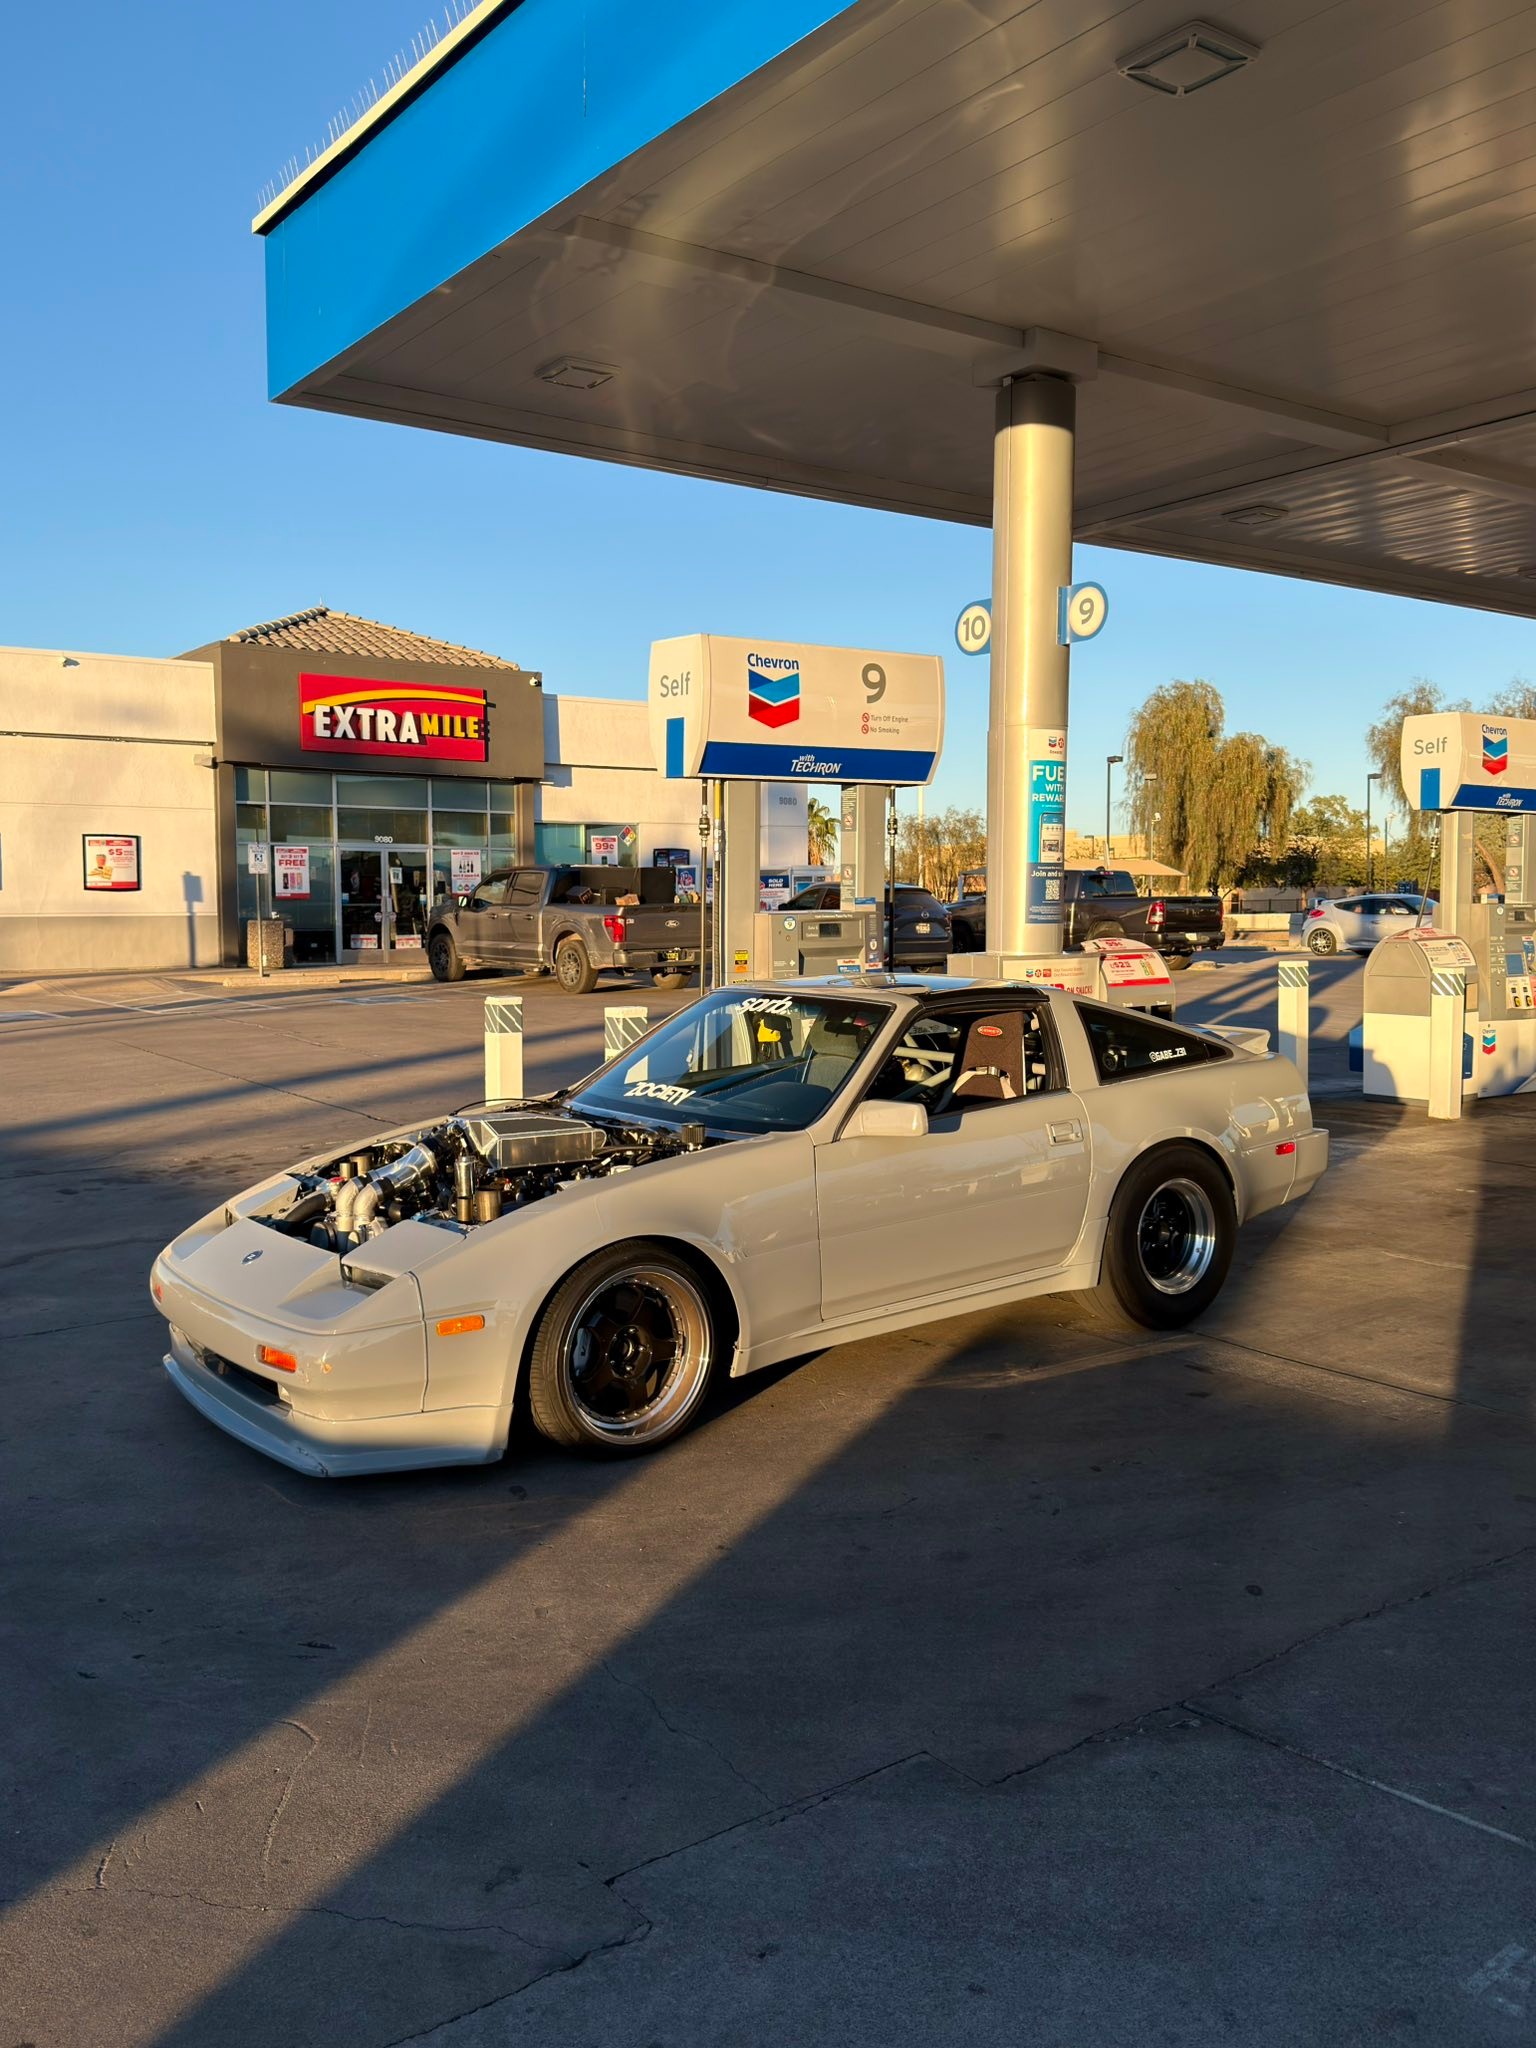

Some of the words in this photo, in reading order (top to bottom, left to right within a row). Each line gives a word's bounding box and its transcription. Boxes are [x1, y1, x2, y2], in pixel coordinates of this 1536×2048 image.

[1079, 598, 1094, 624] 9
[962, 615, 986, 642] 10
[748, 653, 799, 670] Chevron
[660, 671, 690, 698] Self
[862, 662, 886, 704] 9
[314, 704, 420, 744] EXTRA
[420, 712, 479, 738] MILE
[1482, 724, 1507, 736] Chevron
[1414, 737, 1448, 755] Self
[799, 754, 815, 762] with
[790, 760, 841, 775] TECHRON
[1032, 765, 1064, 781] FUE
[779, 797, 797, 805] 9080
[1032, 794, 1064, 802] REWAR
[1496, 797, 1524, 808] TECHRON
[624, 1082, 696, 1106] ZOCIETY
